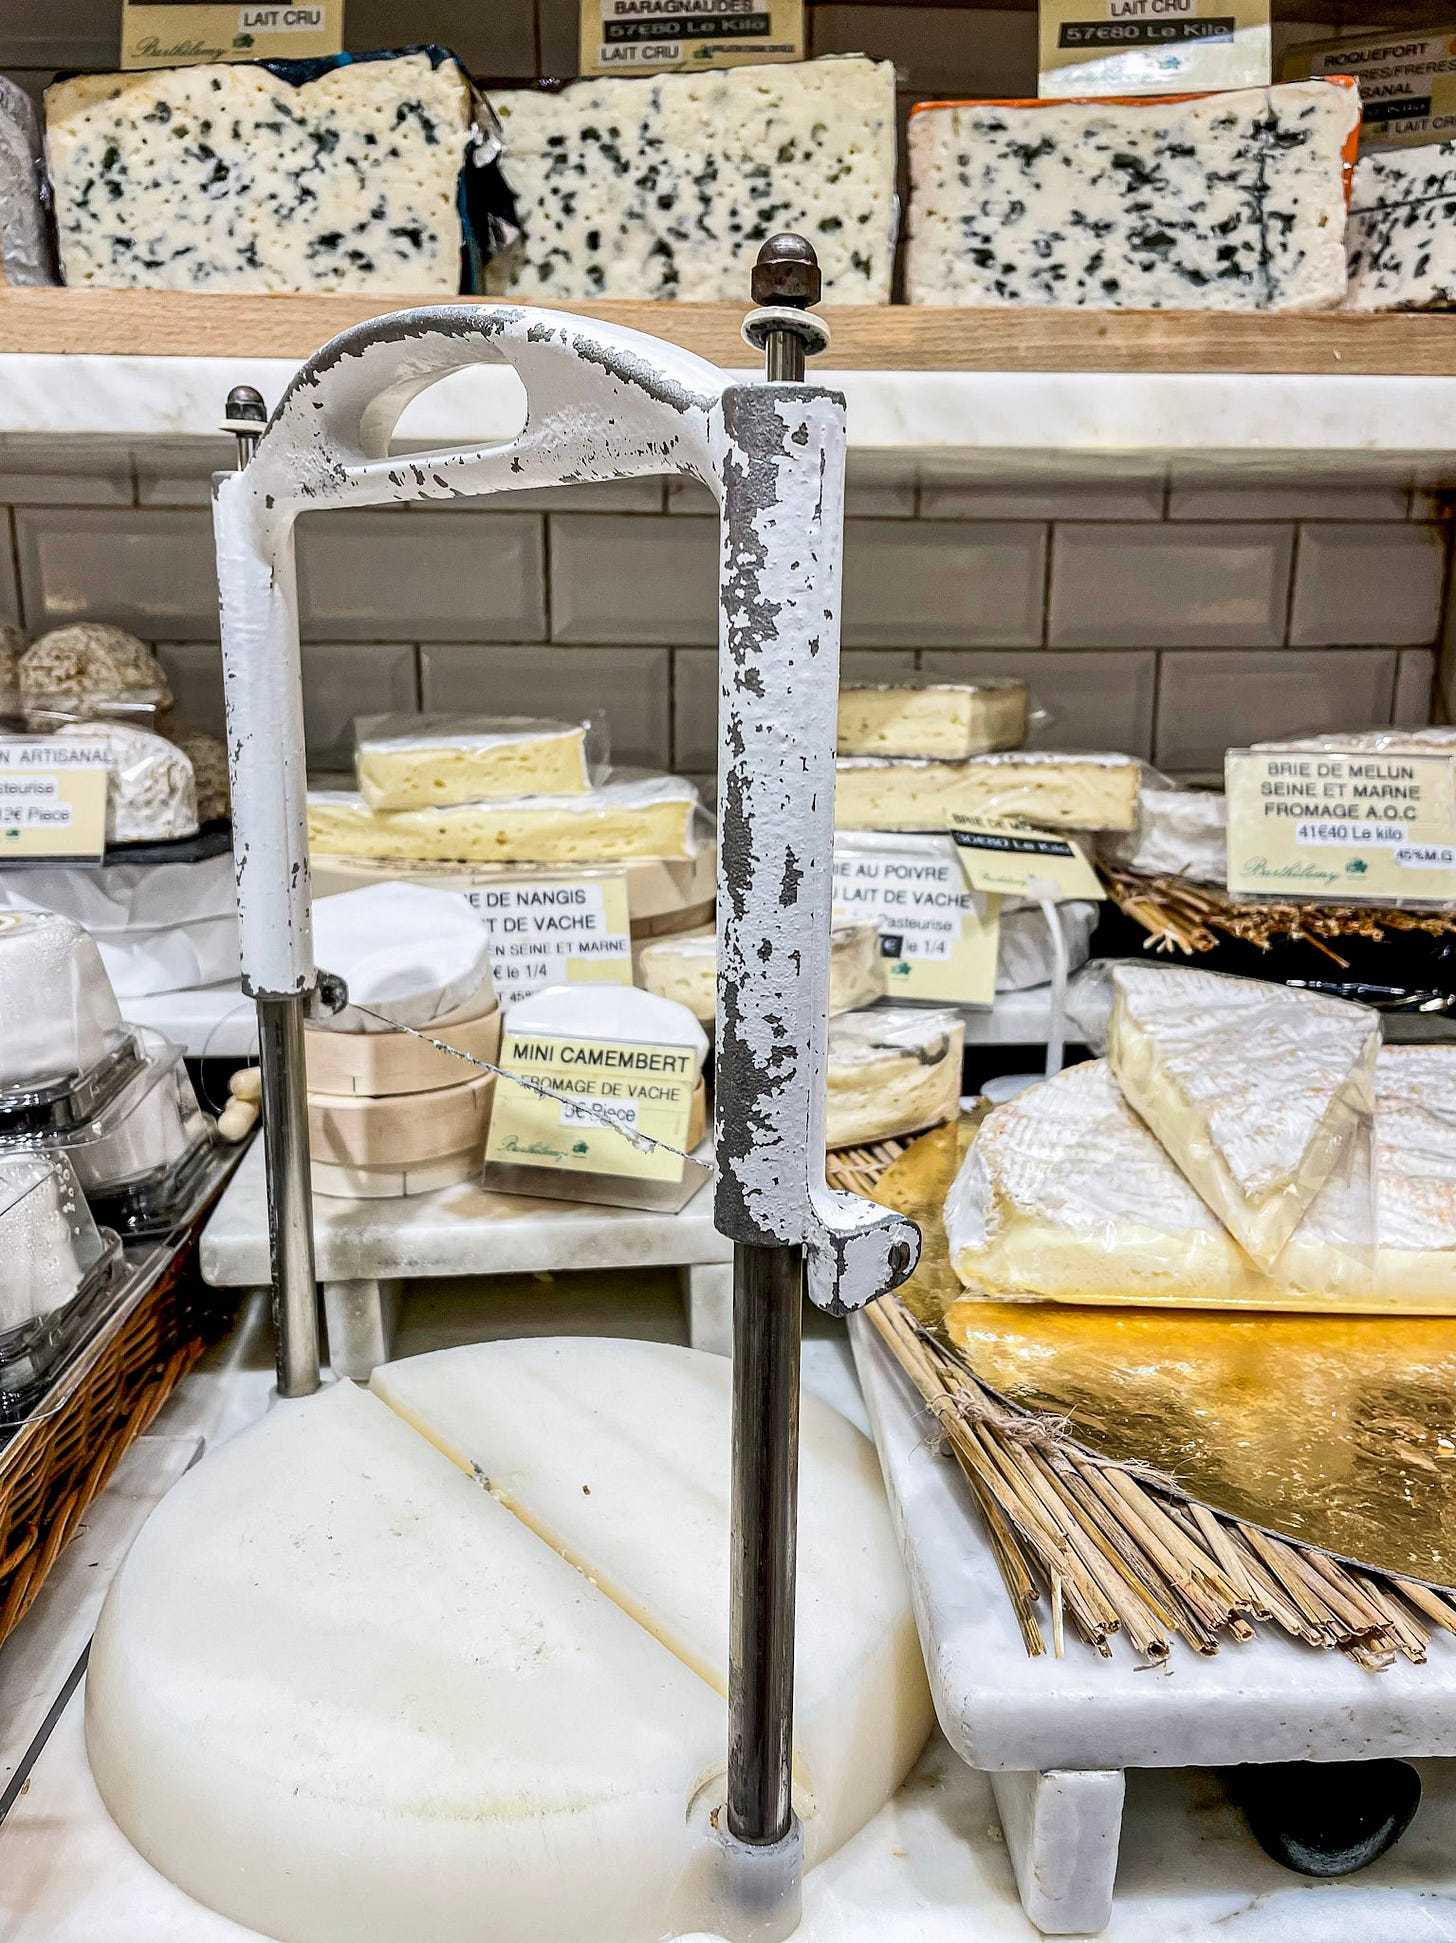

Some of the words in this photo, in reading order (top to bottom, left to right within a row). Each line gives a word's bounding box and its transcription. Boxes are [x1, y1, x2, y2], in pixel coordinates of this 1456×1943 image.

[1110, 0, 1147, 17] LAIT
[1151, 0, 1191, 14] CRU
[243, 11, 279, 27] LAIT
[283, 10, 321, 26] CRU
[686, 20, 715, 33] Le
[722, 17, 768, 32] Kilo
[1146, 25, 1177, 37] Le
[601, 47, 637, 61] LAIT
[641, 45, 680, 60] CRU
[1324, 42, 1430, 67] ROQUEFORT
[1395, 117, 1430, 134] LAIT
[20, 747, 113, 763] ARTISANAL
[1268, 761, 1312, 776] BRIE
[1317, 763, 1343, 777] DE
[1349, 764, 1414, 780] MELUN
[1260, 781, 1317, 797] SEINE
[1323, 783, 1348, 797] ET
[1353, 785, 1421, 800] MARNE
[1264, 802, 1360, 819] FROMAGE
[1366, 805, 1417, 821] A.O.C
[1298, 824, 1348, 839] 41€40
[1352, 826, 1371, 840] Le
[1376, 826, 1403, 841] kilo
[856, 863, 879, 878] AU
[884, 864, 949, 881] POIVRE
[463, 892, 481, 908] E
[486, 891, 511, 908] DE
[517, 888, 586, 906] NANGIS
[843, 886, 879, 902] LAIT
[884, 888, 907, 905] DE
[912, 892, 971, 910] VACHE
[482, 916, 498, 933] T
[503, 916, 529, 932] DE
[534, 914, 596, 931] VACHE
[510, 942, 550, 956] SEINE
[555, 941, 573, 954] ET
[579, 938, 628, 953] MARNE
[906, 939, 918, 953] le
[924, 940, 946, 954] 1/4
[507, 963, 520, 980] le
[526, 962, 548, 978] 1/4
[512, 1042, 555, 1062] MINI
[560, 1046, 690, 1074] CAMEMBERT
[520, 1074, 597, 1095] FROMAGE
[601, 1081, 621, 1096] DE
[628, 1083, 681, 1102] VACHE
